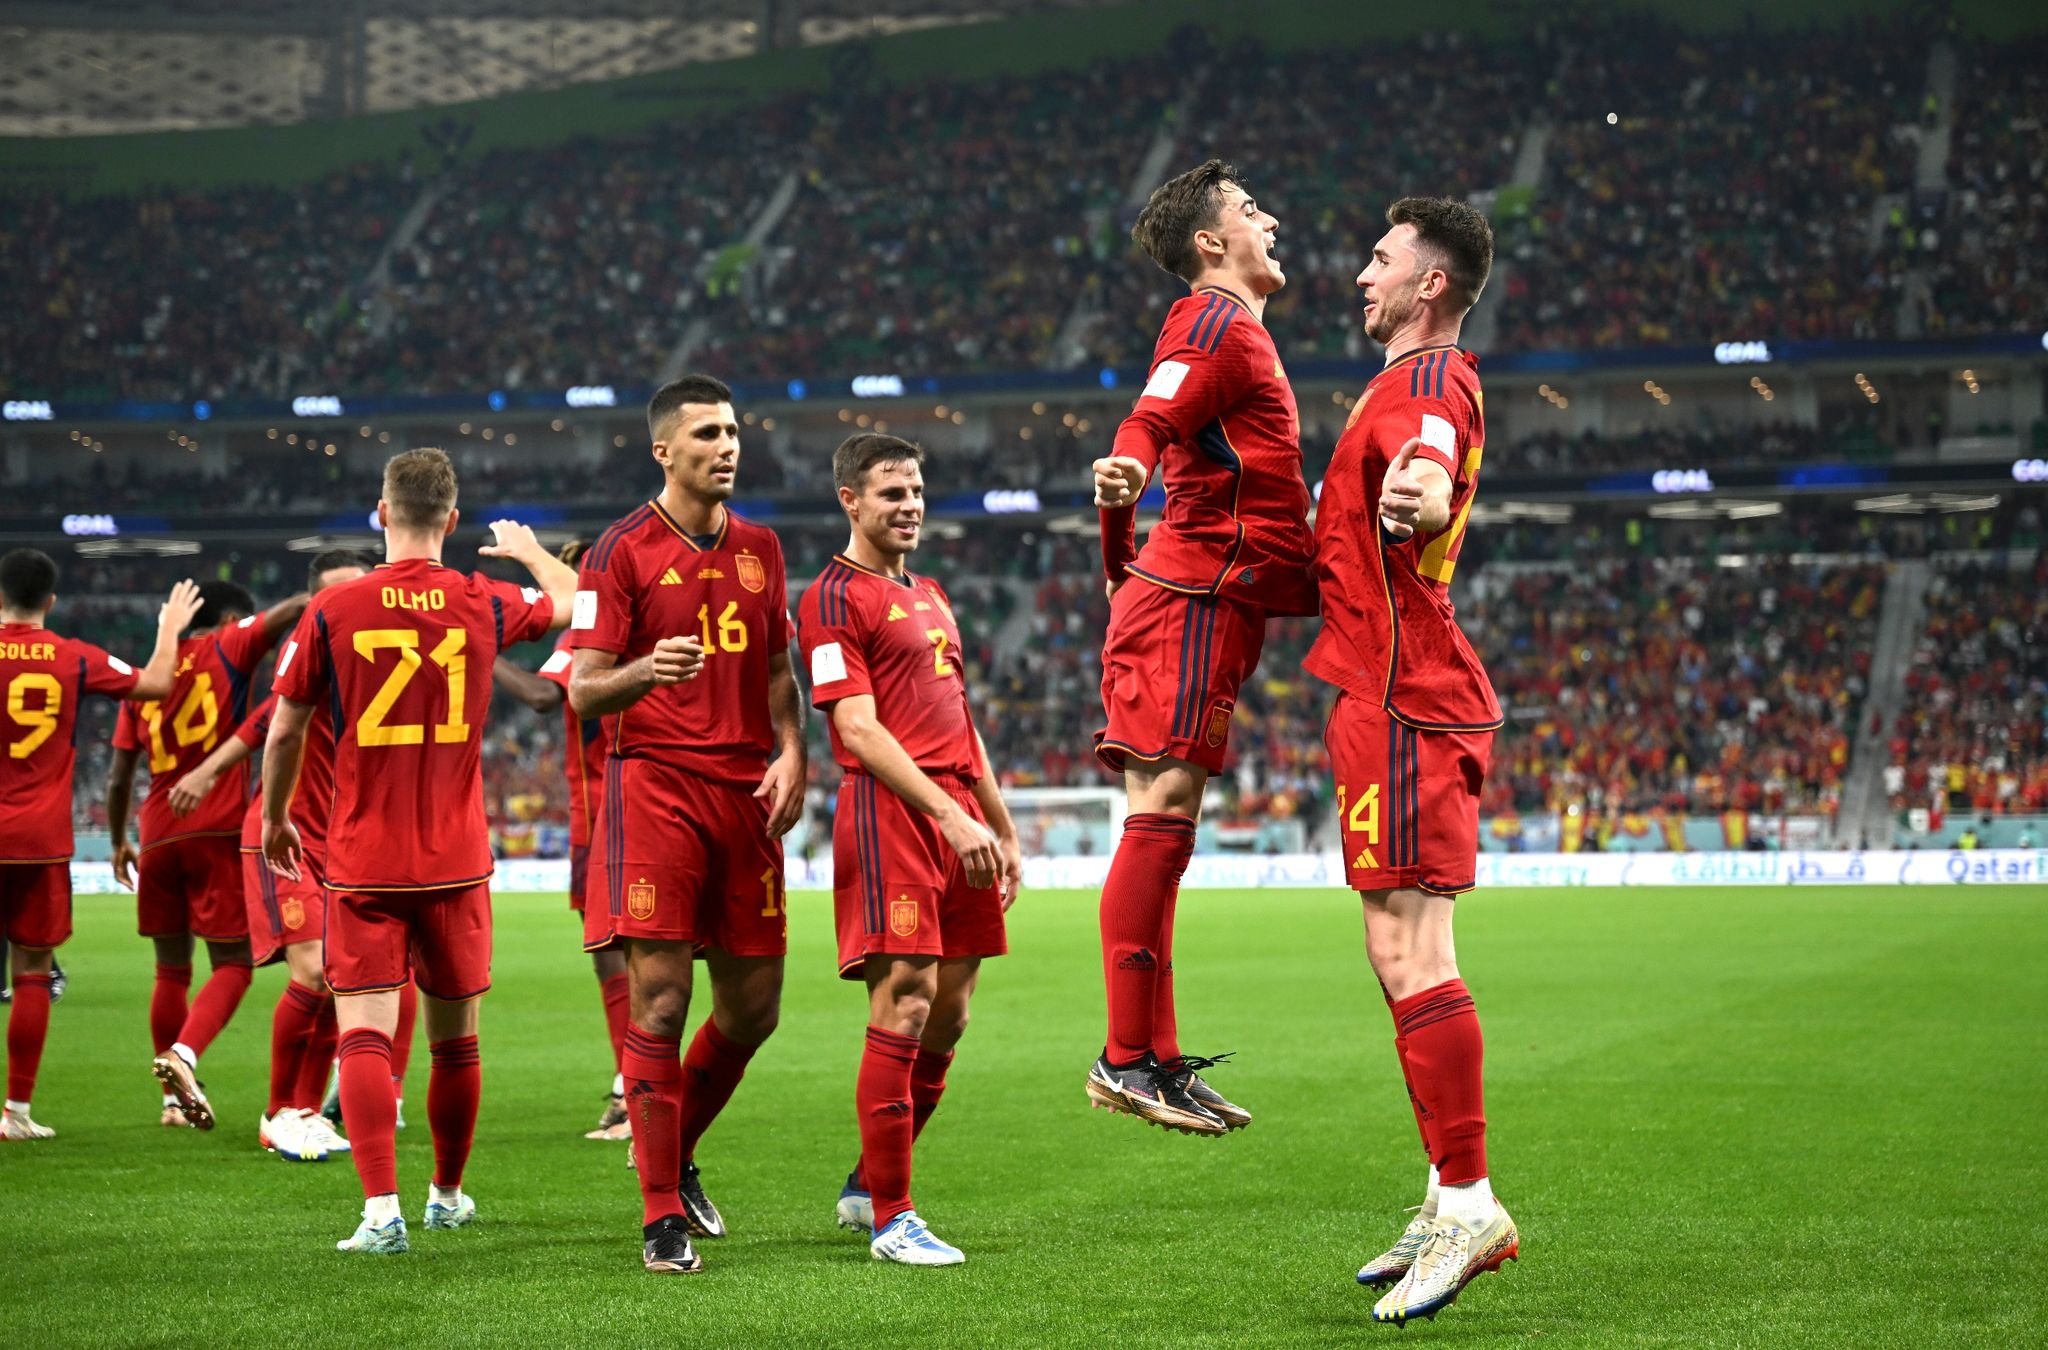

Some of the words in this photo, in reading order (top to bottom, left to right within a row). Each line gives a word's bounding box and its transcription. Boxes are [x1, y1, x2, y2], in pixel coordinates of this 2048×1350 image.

[381, 586, 446, 611] OLMO
[697, 601, 748, 654] 16
[925, 629, 954, 675] 2
[7, 672, 62, 759] 9
[141, 671, 219, 774] 14
[352, 628, 470, 747] 21
